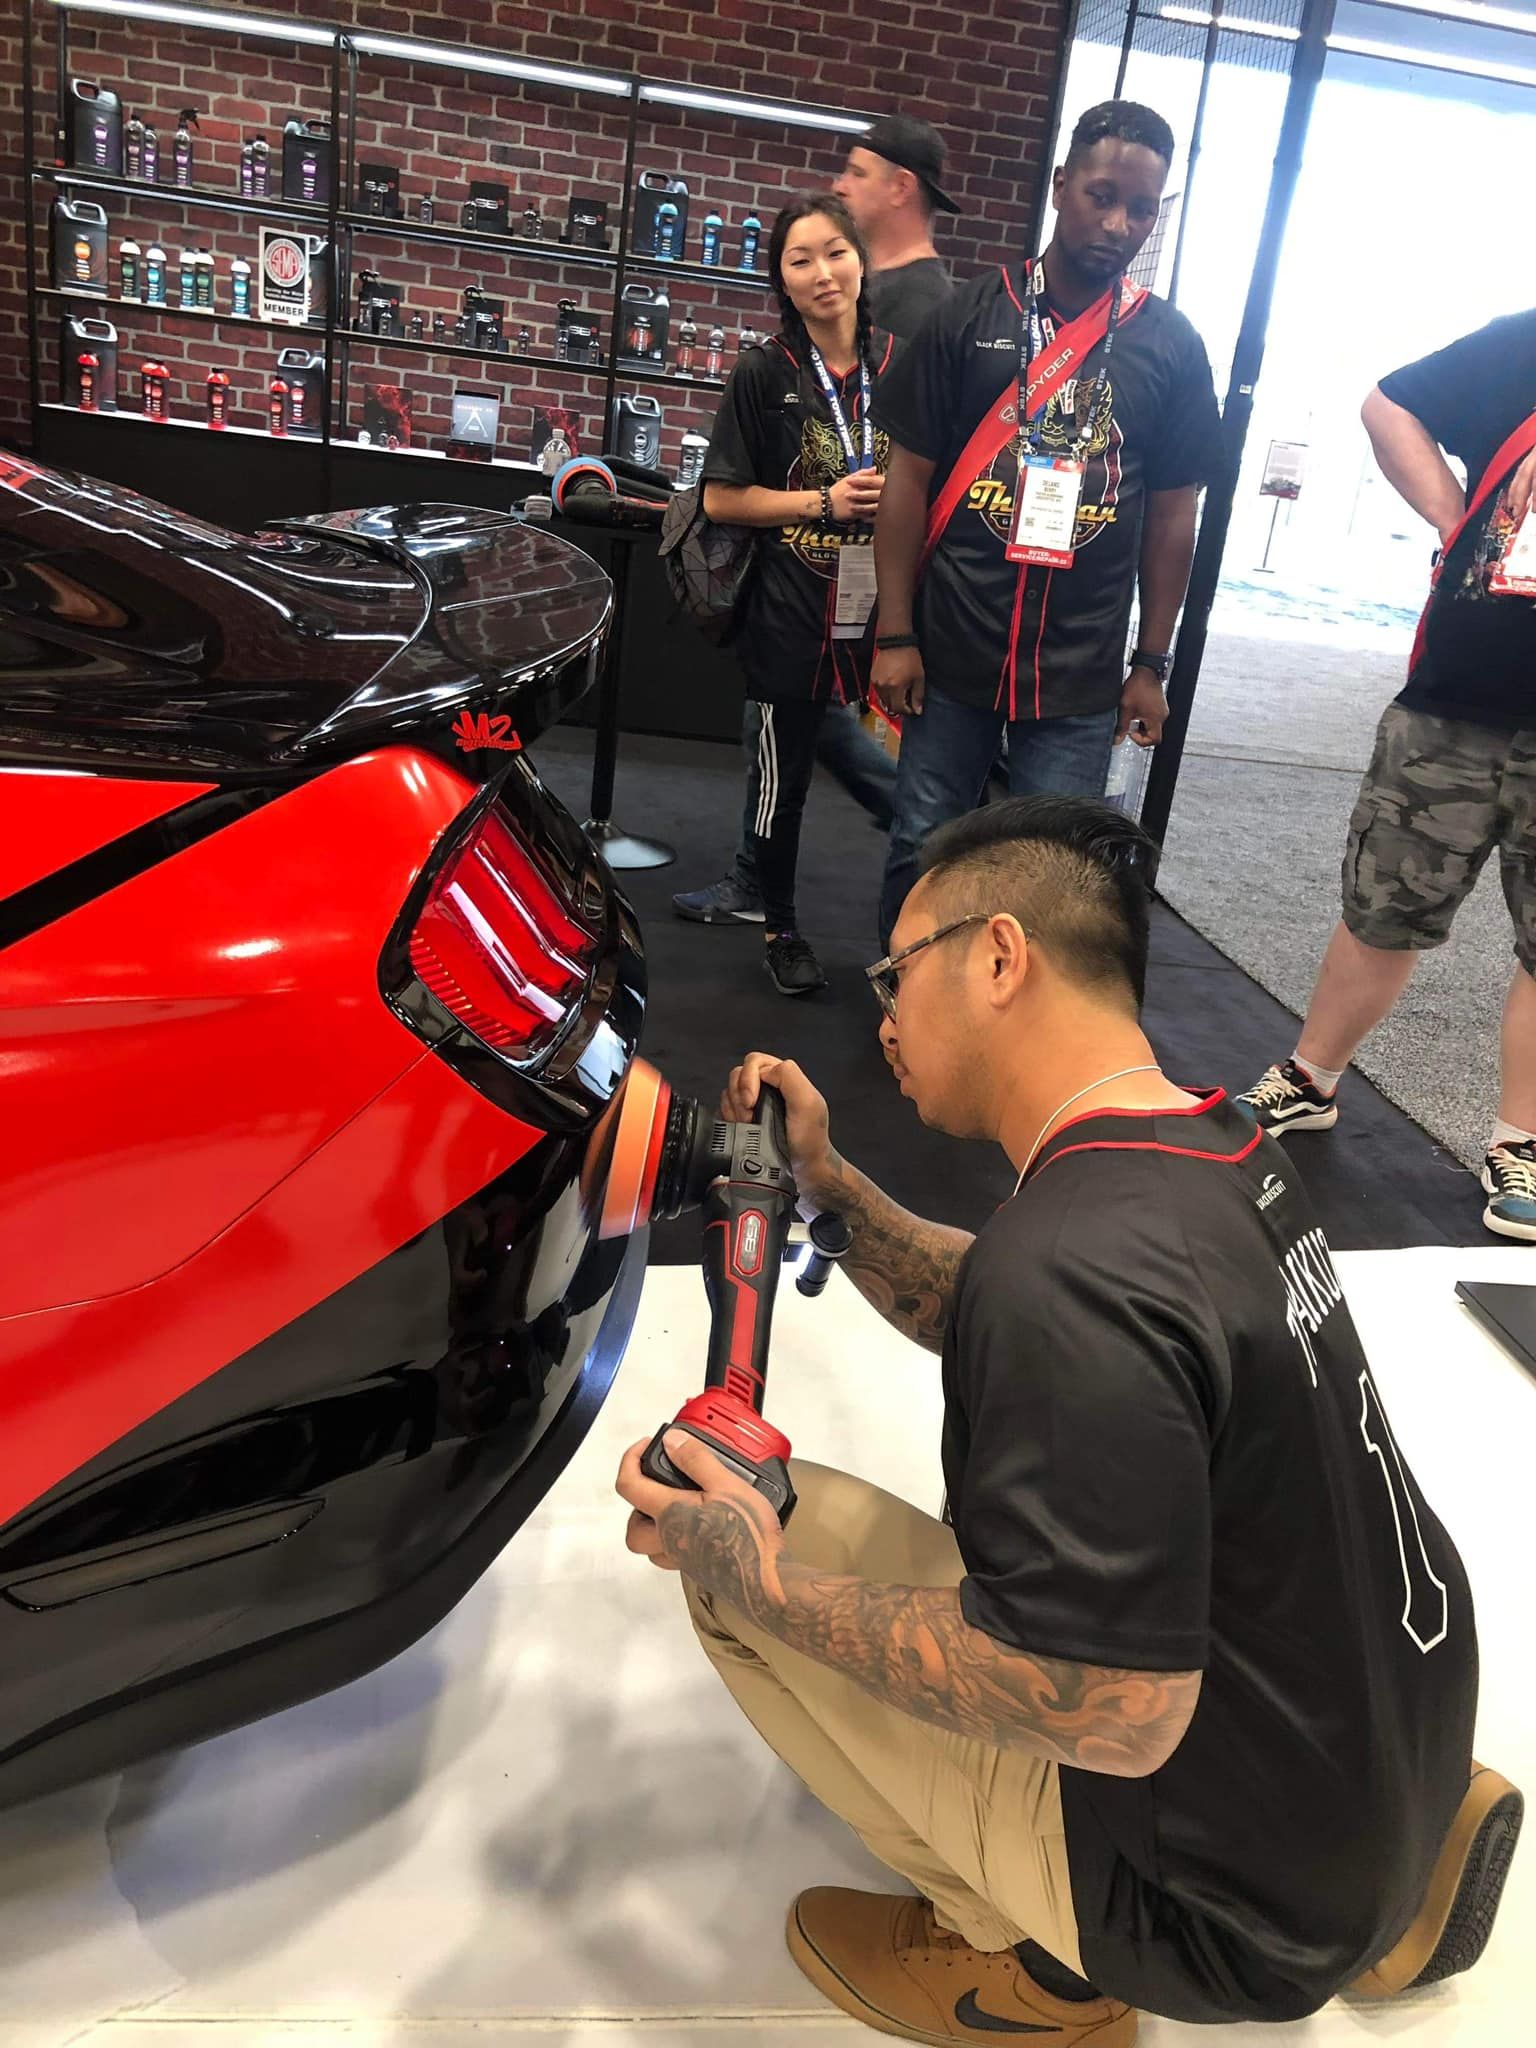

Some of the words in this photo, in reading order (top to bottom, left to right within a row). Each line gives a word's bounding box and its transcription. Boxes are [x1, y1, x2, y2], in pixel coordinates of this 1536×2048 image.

[264, 303, 304, 317] MEMBER
[1104, 333, 1114, 353] STEK
[1024, 347, 1075, 402] PYDER
[1096, 368, 1107, 390] STEK
[830, 396, 844, 426] TOYO
[1018, 386, 1026, 411] STEK
[864, 426, 873, 455] TOYO
